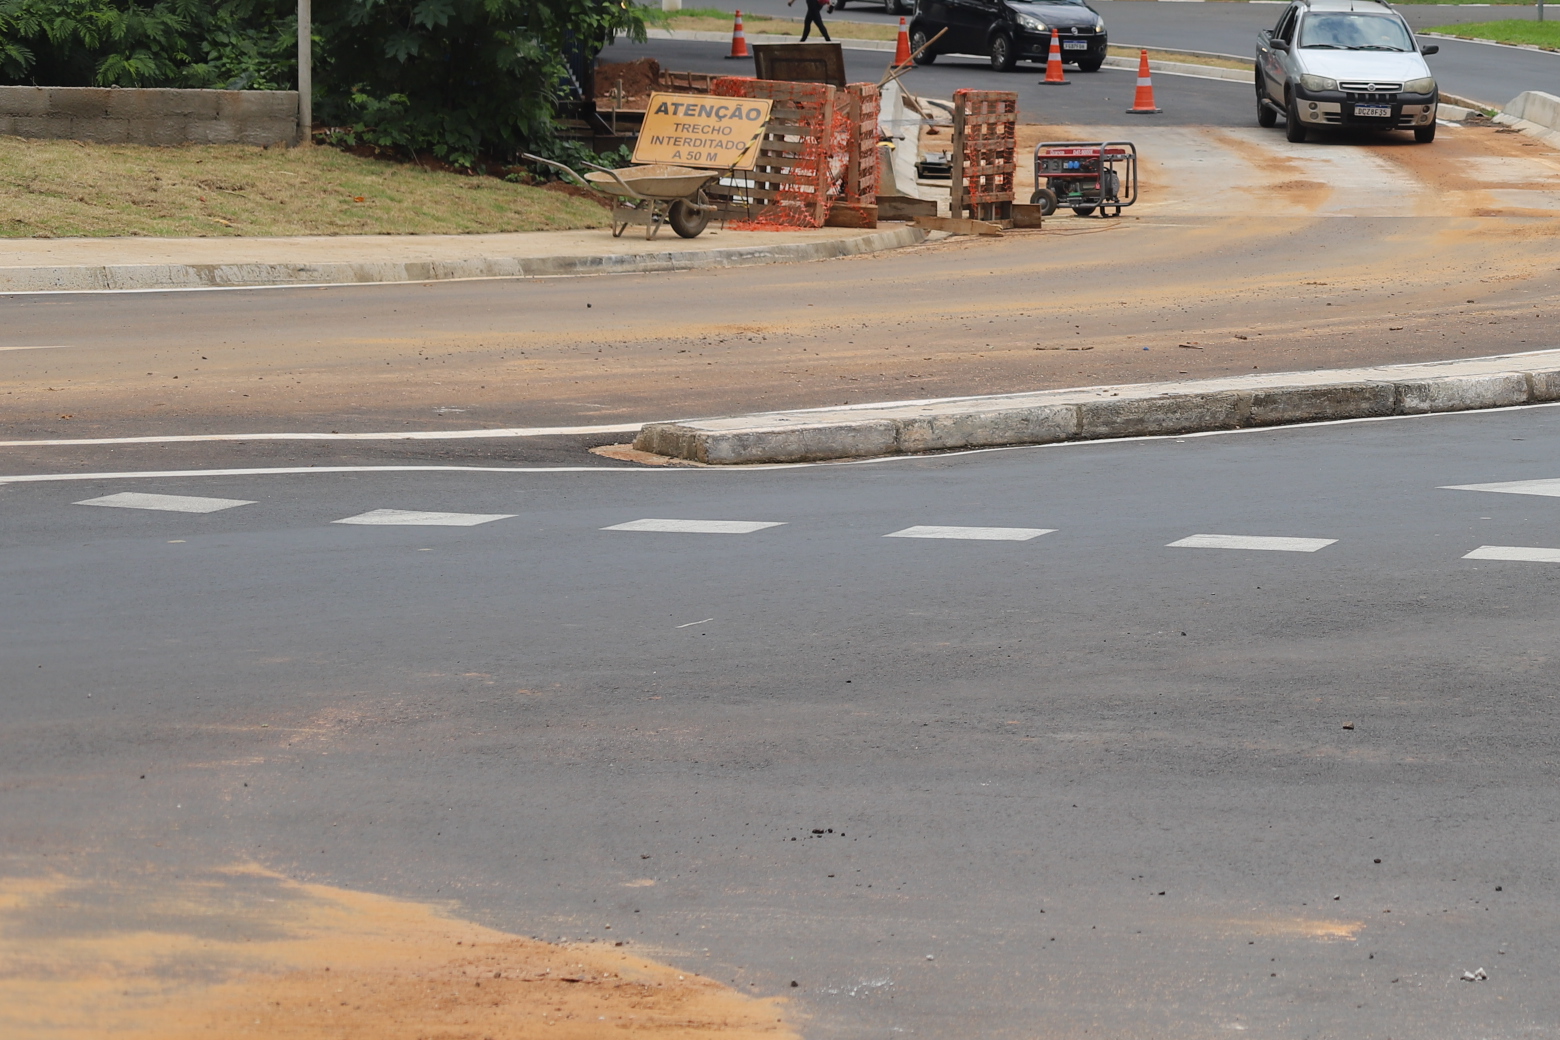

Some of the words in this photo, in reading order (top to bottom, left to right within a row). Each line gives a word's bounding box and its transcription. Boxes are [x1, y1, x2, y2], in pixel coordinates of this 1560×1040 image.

[654, 102, 761, 122] ATENÇÃO
[674, 123, 732, 136] TRECHO
[650, 135, 746, 150] INTERDITADO
[672, 150, 682, 159] A
[686, 151, 702, 161] 50
[705, 153, 718, 162] M
